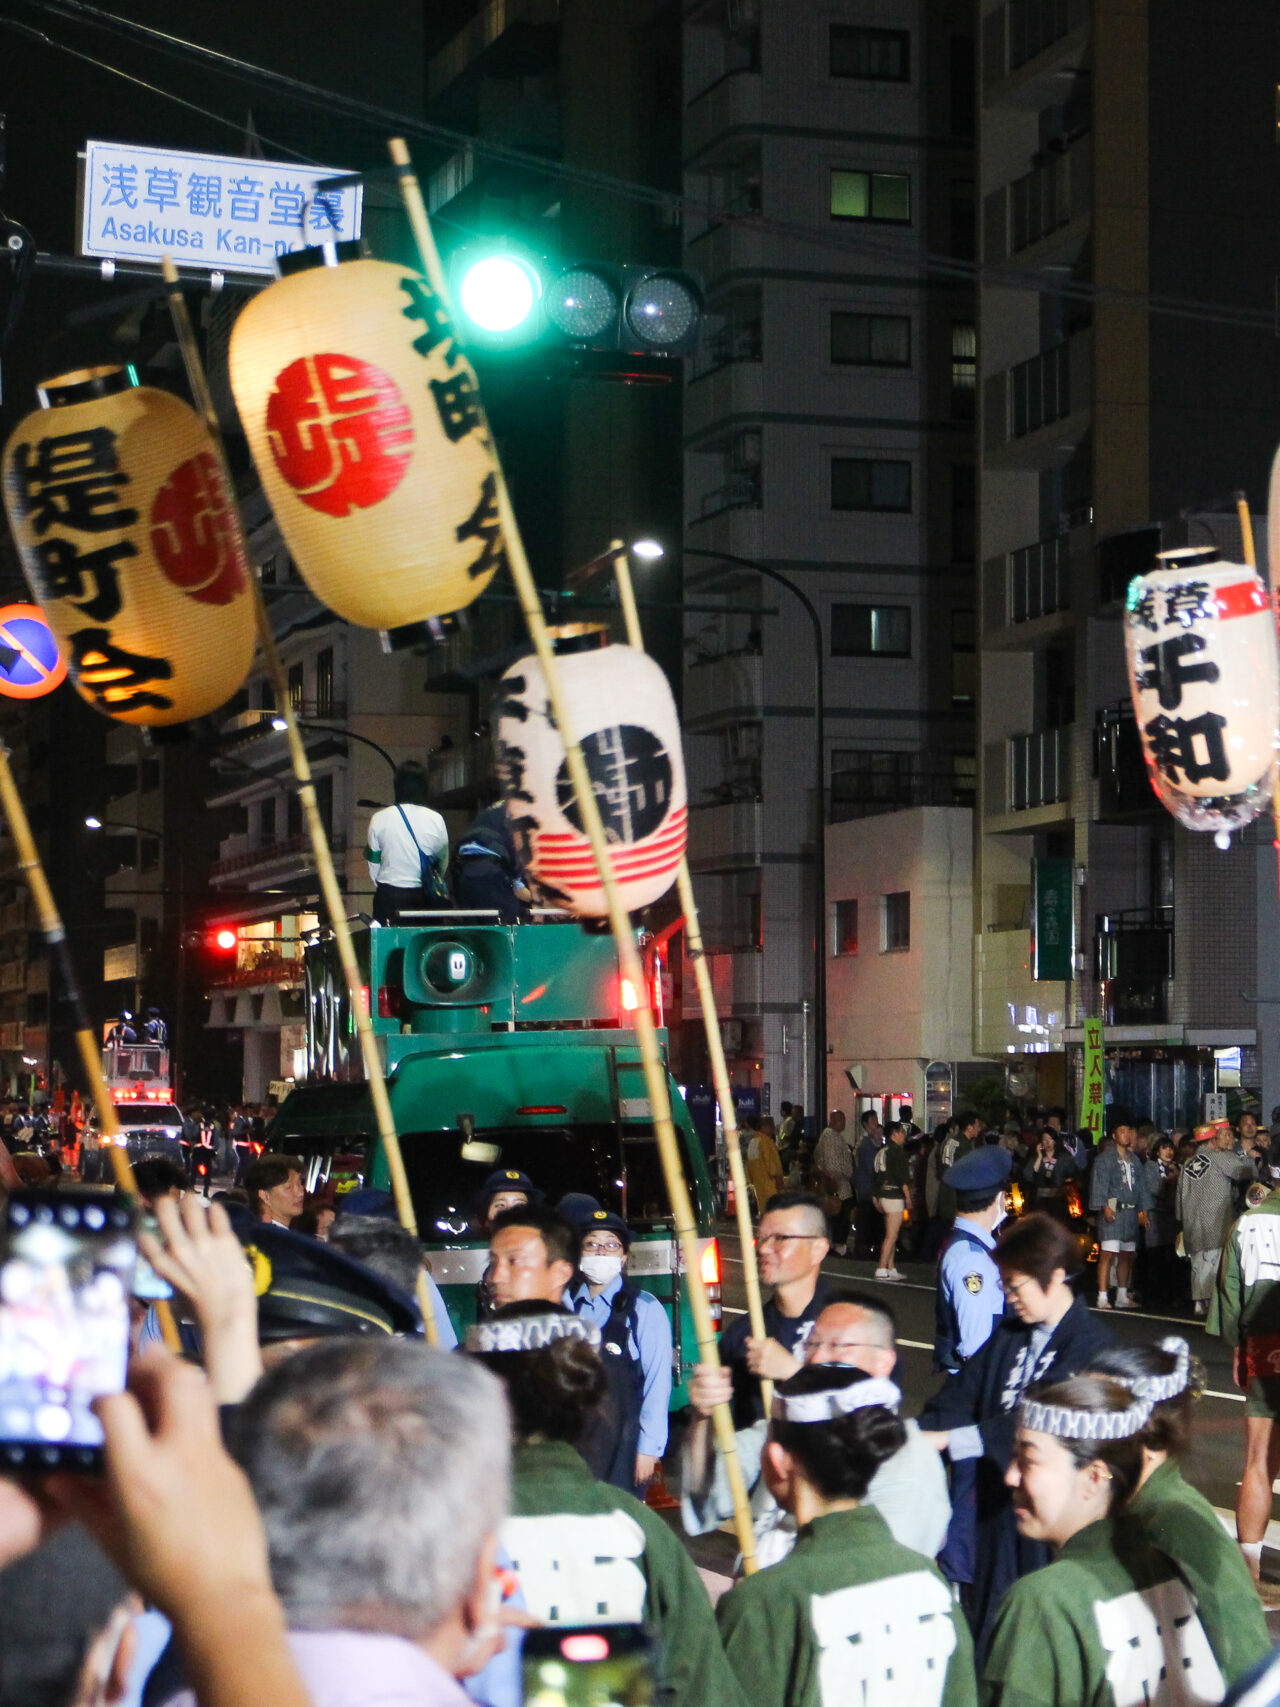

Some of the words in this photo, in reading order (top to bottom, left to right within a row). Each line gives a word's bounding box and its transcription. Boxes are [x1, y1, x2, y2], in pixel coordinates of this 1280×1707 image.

[100, 162, 345, 233] 浅草観音堂裏
[101, 216, 204, 249] Asakusa
